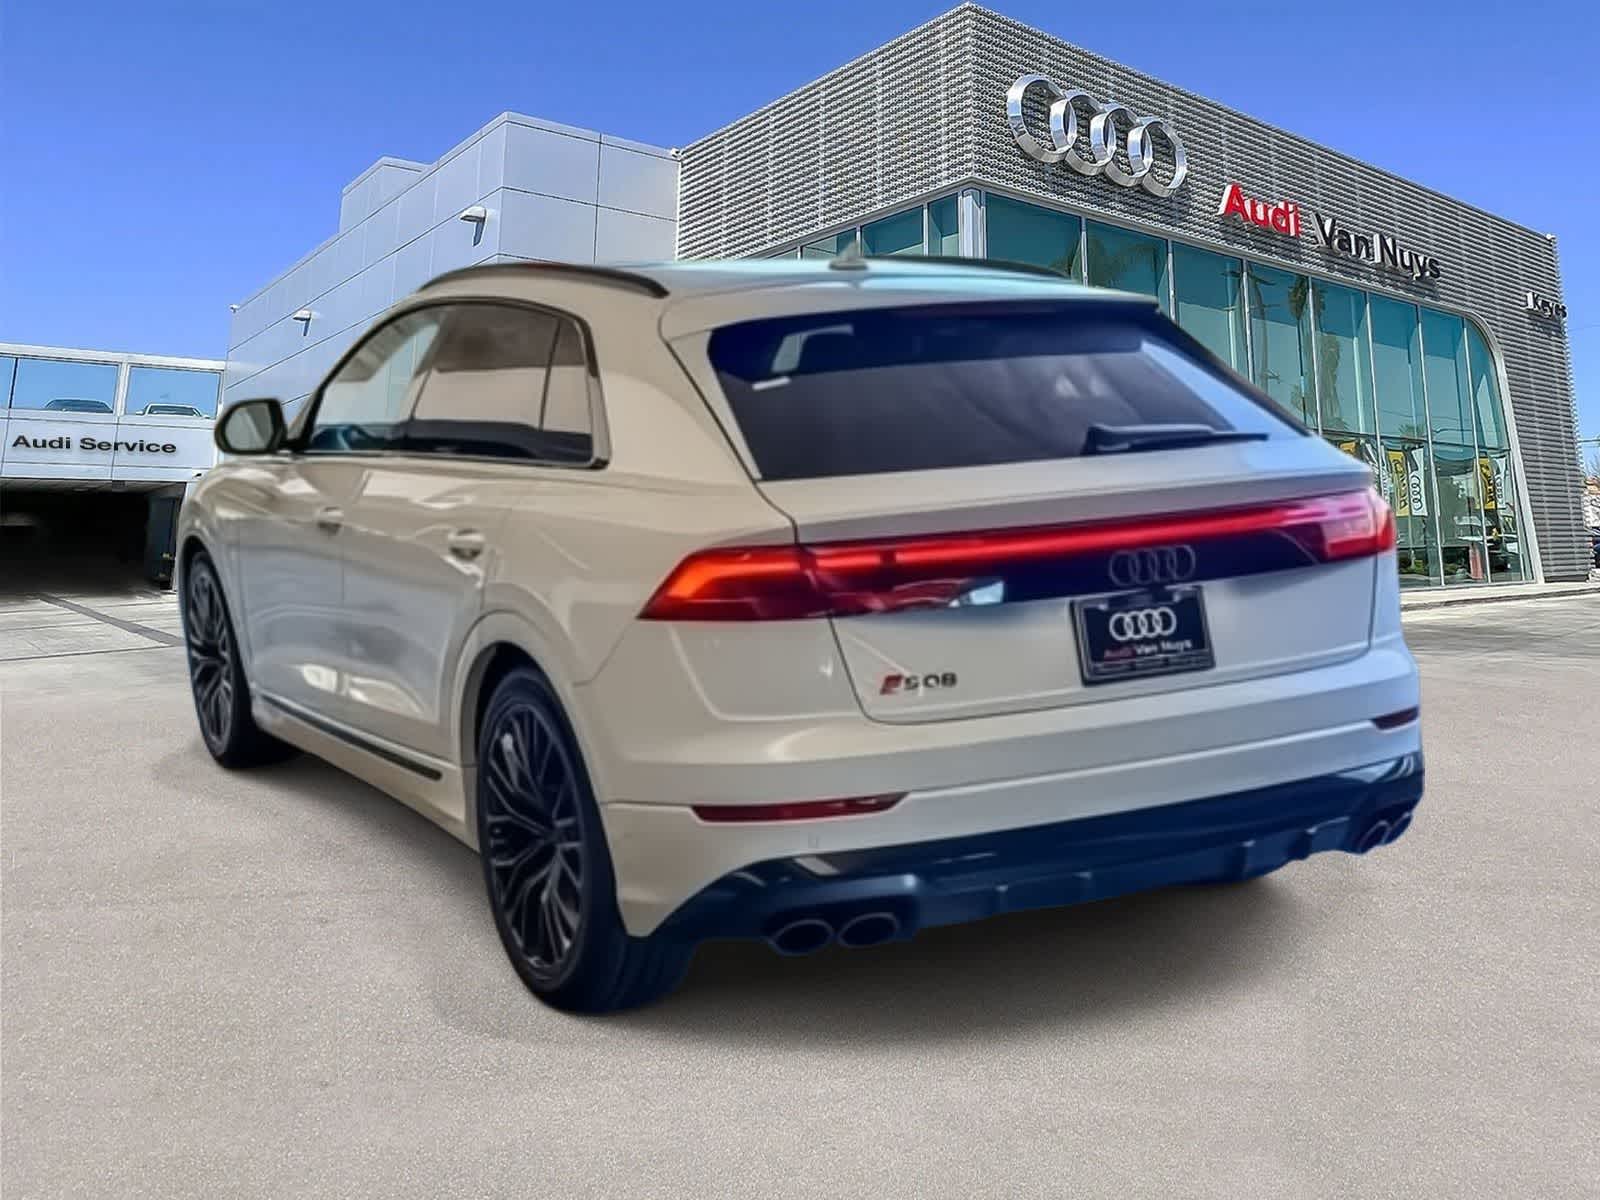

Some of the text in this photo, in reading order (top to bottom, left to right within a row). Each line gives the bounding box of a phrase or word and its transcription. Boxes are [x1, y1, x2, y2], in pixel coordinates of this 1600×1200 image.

[1219, 183, 1441, 281] Audi Van Nuys
[12, 435, 177, 454] Audi Service
[1136, 643, 1158, 655] Van
